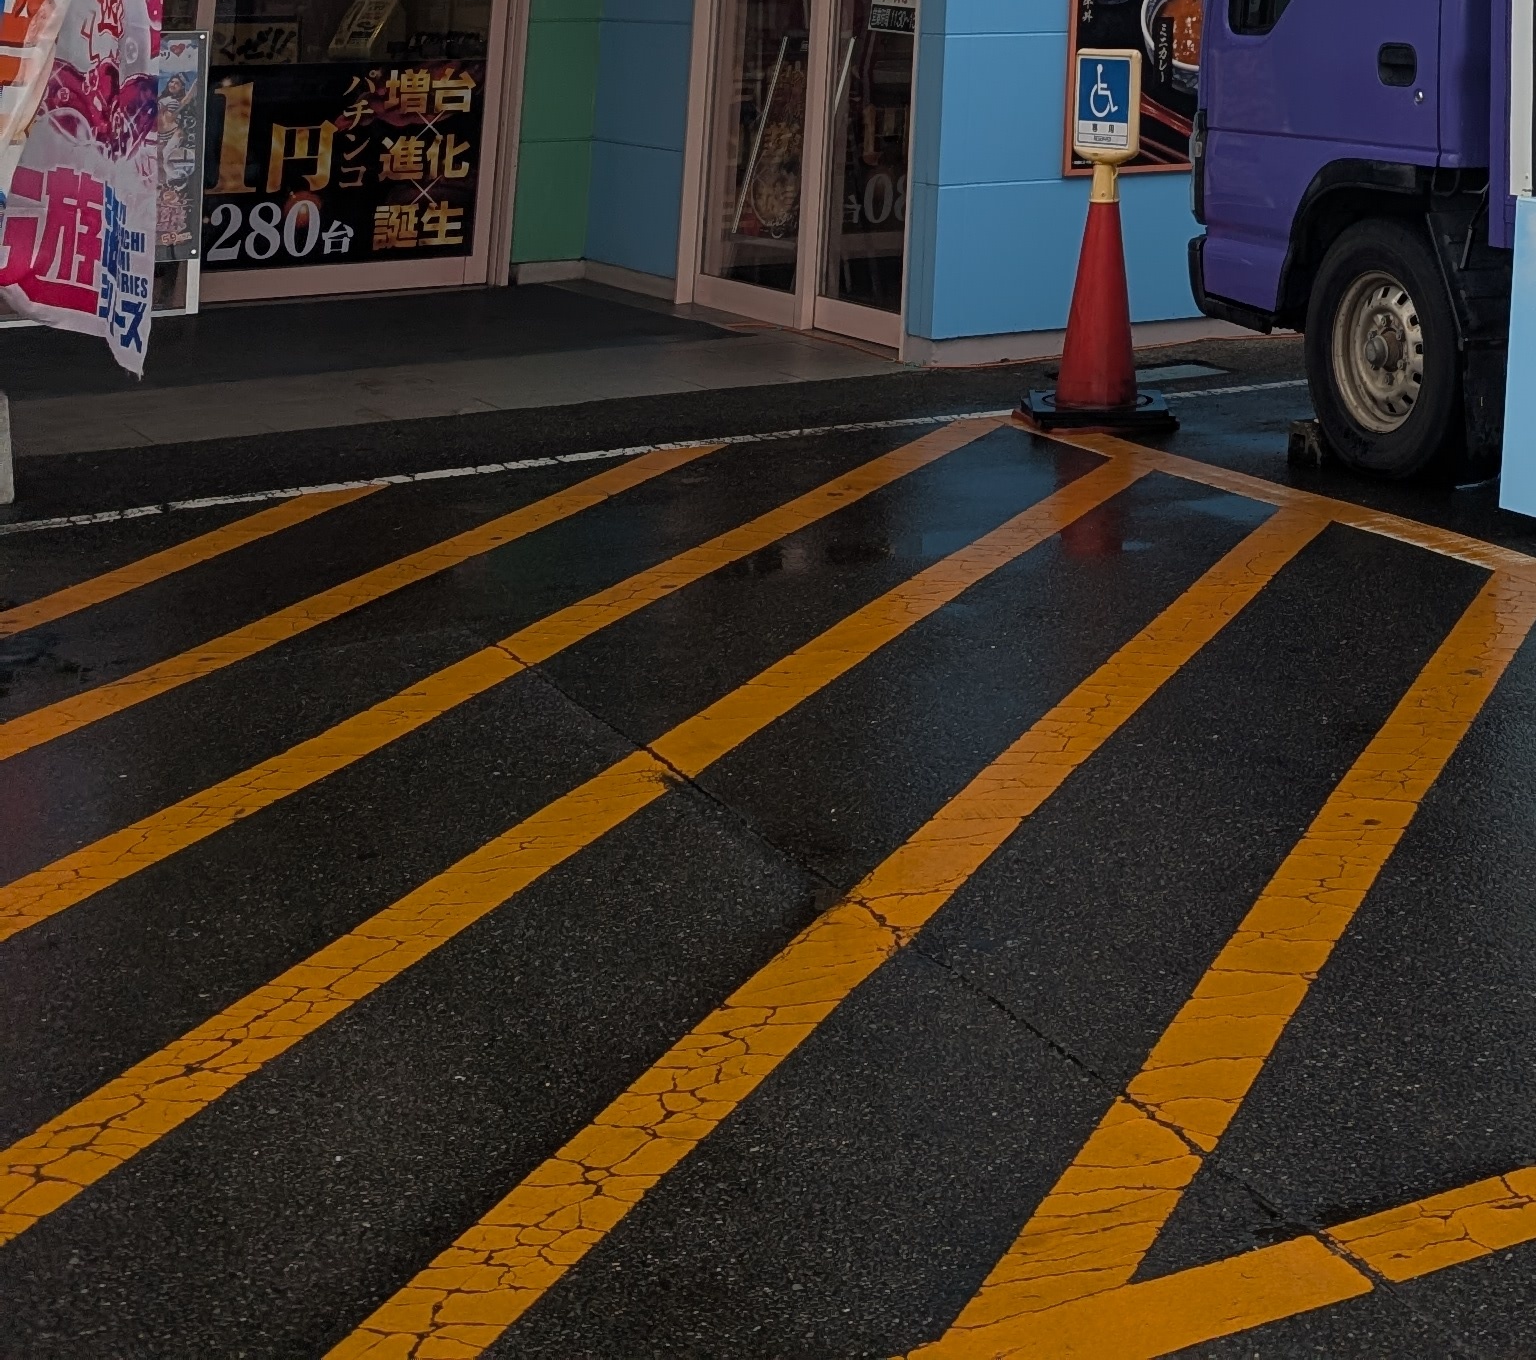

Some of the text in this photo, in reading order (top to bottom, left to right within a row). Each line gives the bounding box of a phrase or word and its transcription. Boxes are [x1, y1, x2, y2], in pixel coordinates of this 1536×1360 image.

[383, 67, 477, 115] 増台
[204, 81, 339, 195] 1円
[339, 68, 381, 189] パチンコ
[379, 133, 471, 182] 進化
[206, 199, 355, 262] 280台
[372, 200, 464, 252] 誕生
